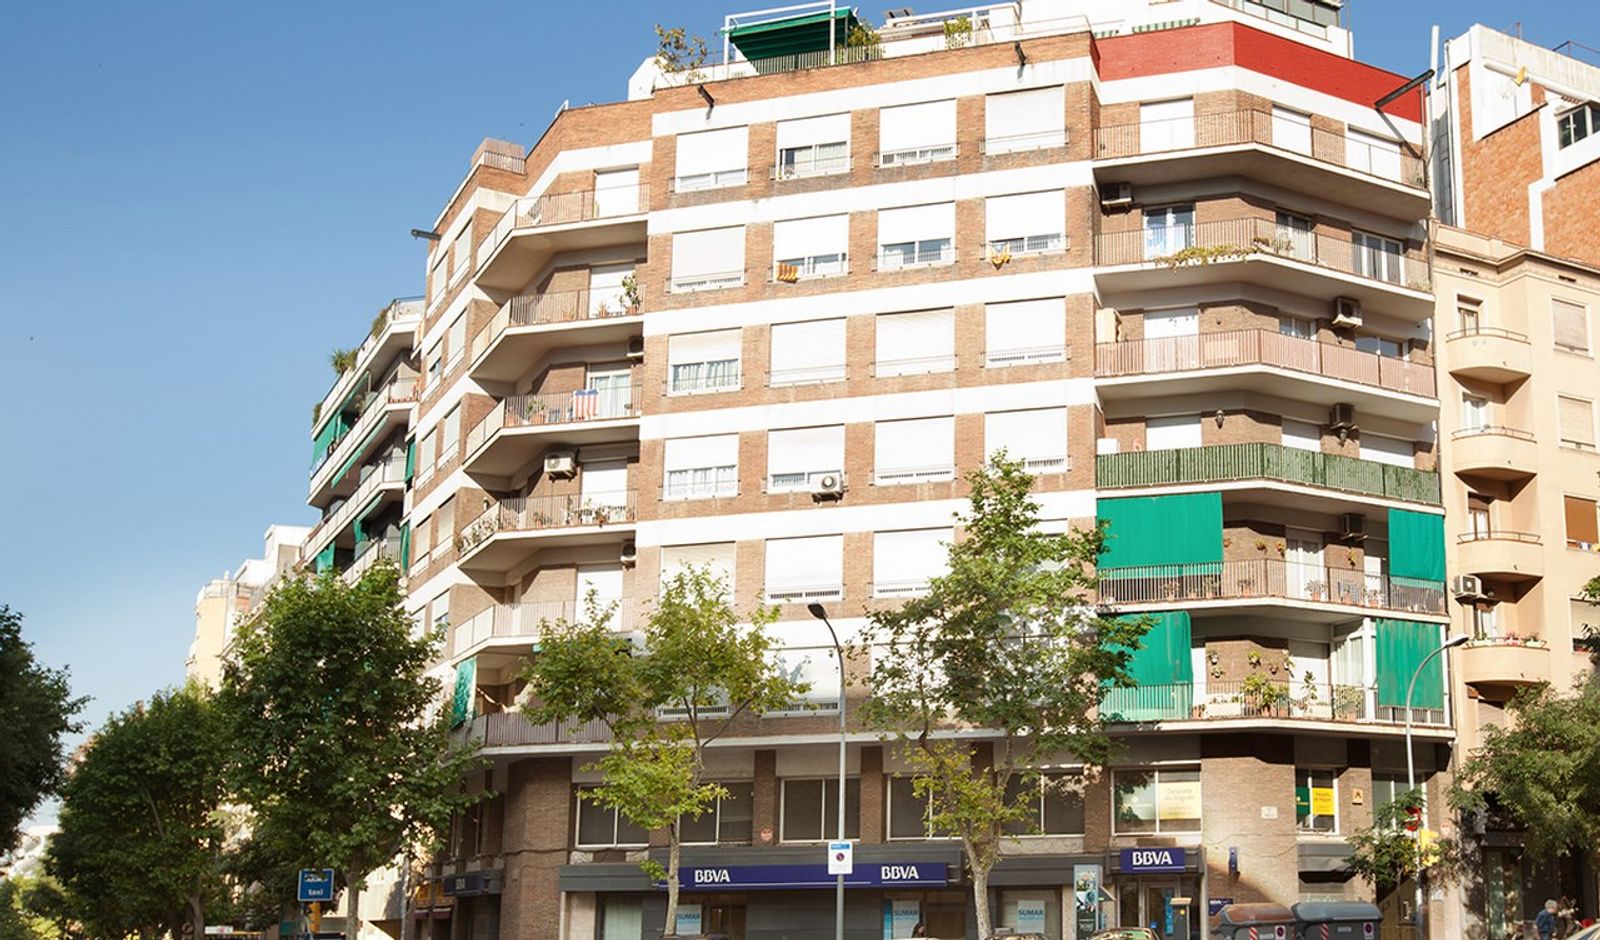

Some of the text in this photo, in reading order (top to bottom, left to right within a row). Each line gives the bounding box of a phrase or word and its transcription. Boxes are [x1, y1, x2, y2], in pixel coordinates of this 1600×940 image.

[1132, 851, 1173, 865] BBVA
[695, 869, 730, 883] BBVA
[881, 866, 919, 879] BBVA
[308, 888, 324, 896] taxi
